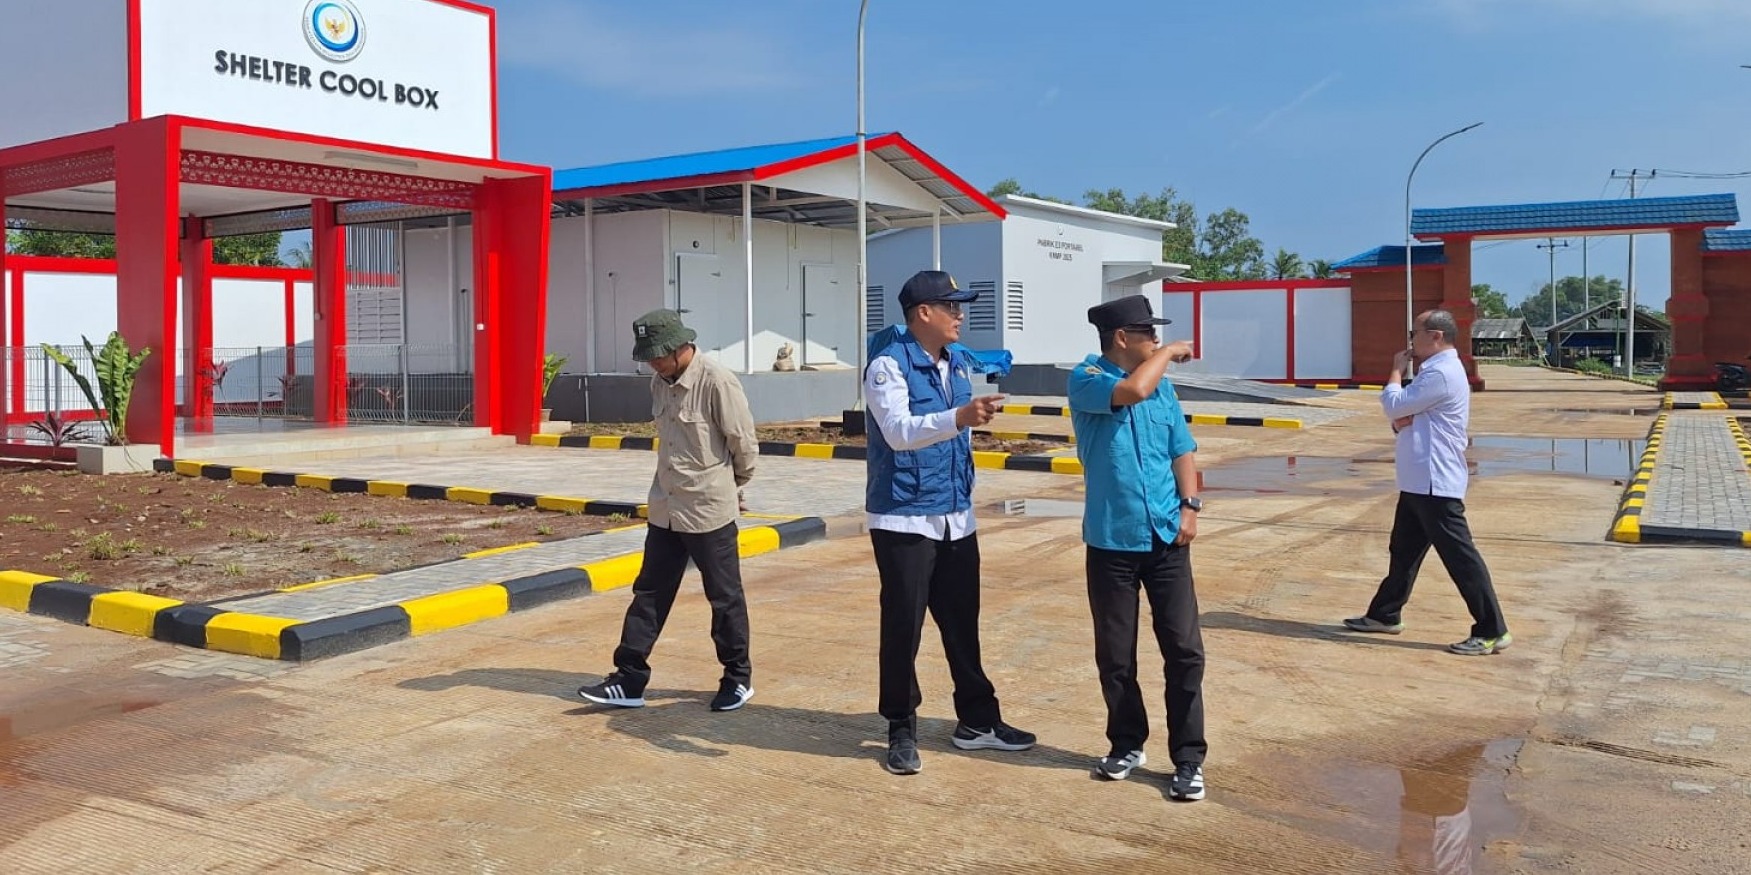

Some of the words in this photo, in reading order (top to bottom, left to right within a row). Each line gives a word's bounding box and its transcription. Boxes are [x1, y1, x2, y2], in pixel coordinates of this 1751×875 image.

[214, 50, 312, 89] SHELTER
[319, 70, 388, 102] COOL
[394, 83, 439, 110] BOX
